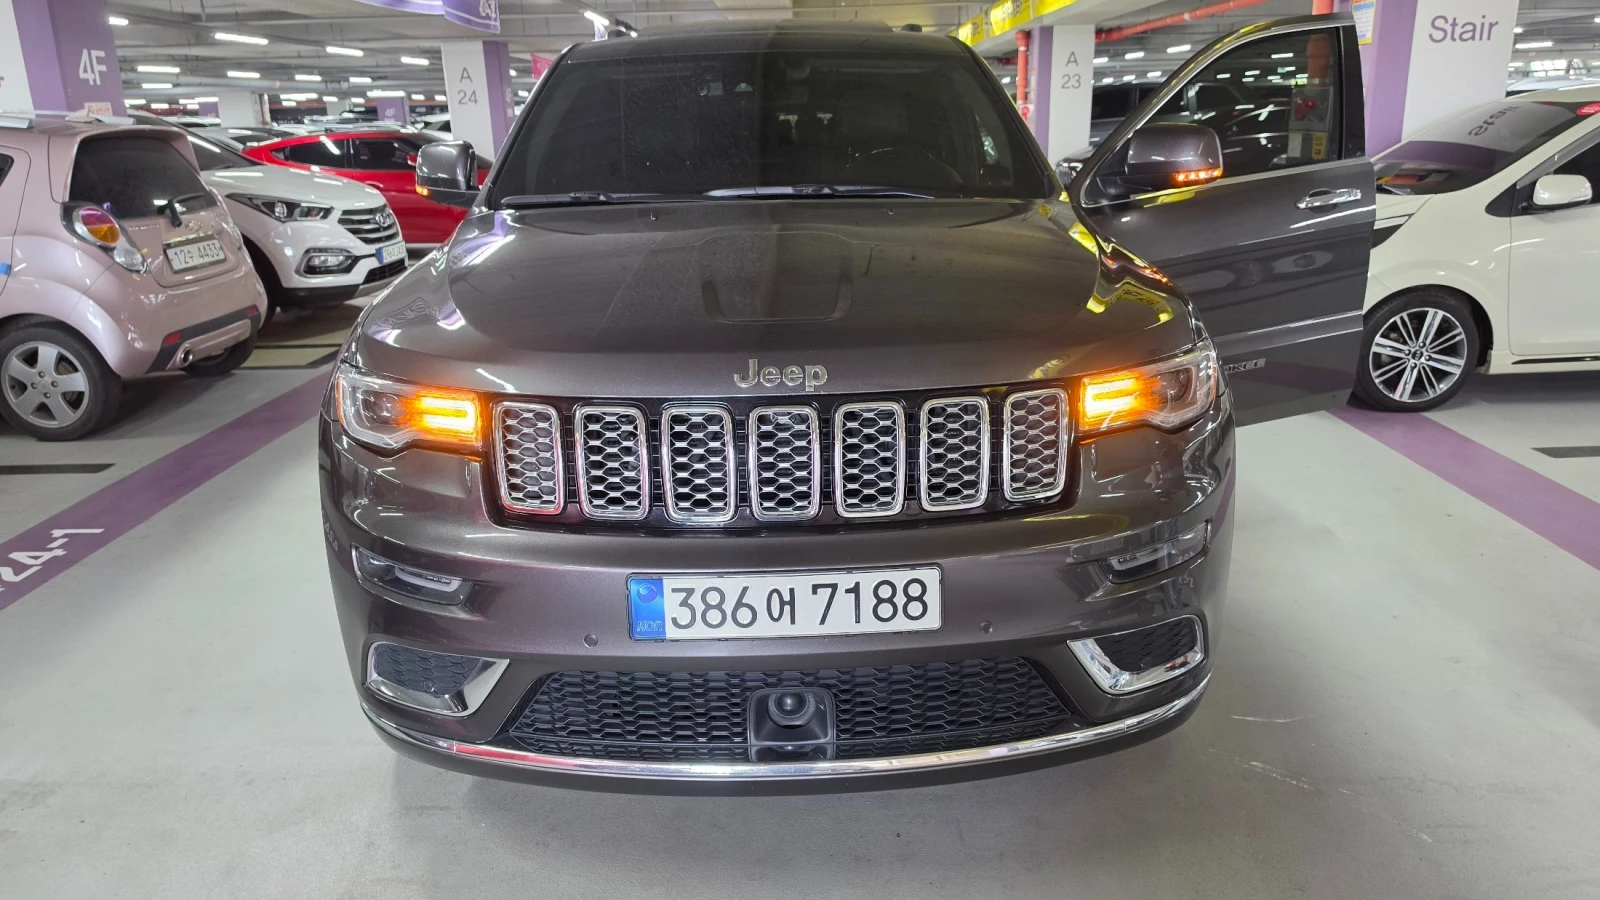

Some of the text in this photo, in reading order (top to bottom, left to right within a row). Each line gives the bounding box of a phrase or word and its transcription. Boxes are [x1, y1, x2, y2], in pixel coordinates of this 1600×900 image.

[1428, 14, 1499, 43] Stair
[78, 48, 107, 86] 4F
[1065, 51, 1079, 67] A
[459, 67, 473, 83] A
[1061, 73, 1081, 89] 23
[457, 89, 478, 105] 24
[174, 242, 220, 265] 12수 4433
[733, 358, 828, 392] Jeep
[0, 528, 105, 592] 24-1
[670, 577, 929, 631] 386어 7188
[636, 620, 663, 632] KOR
